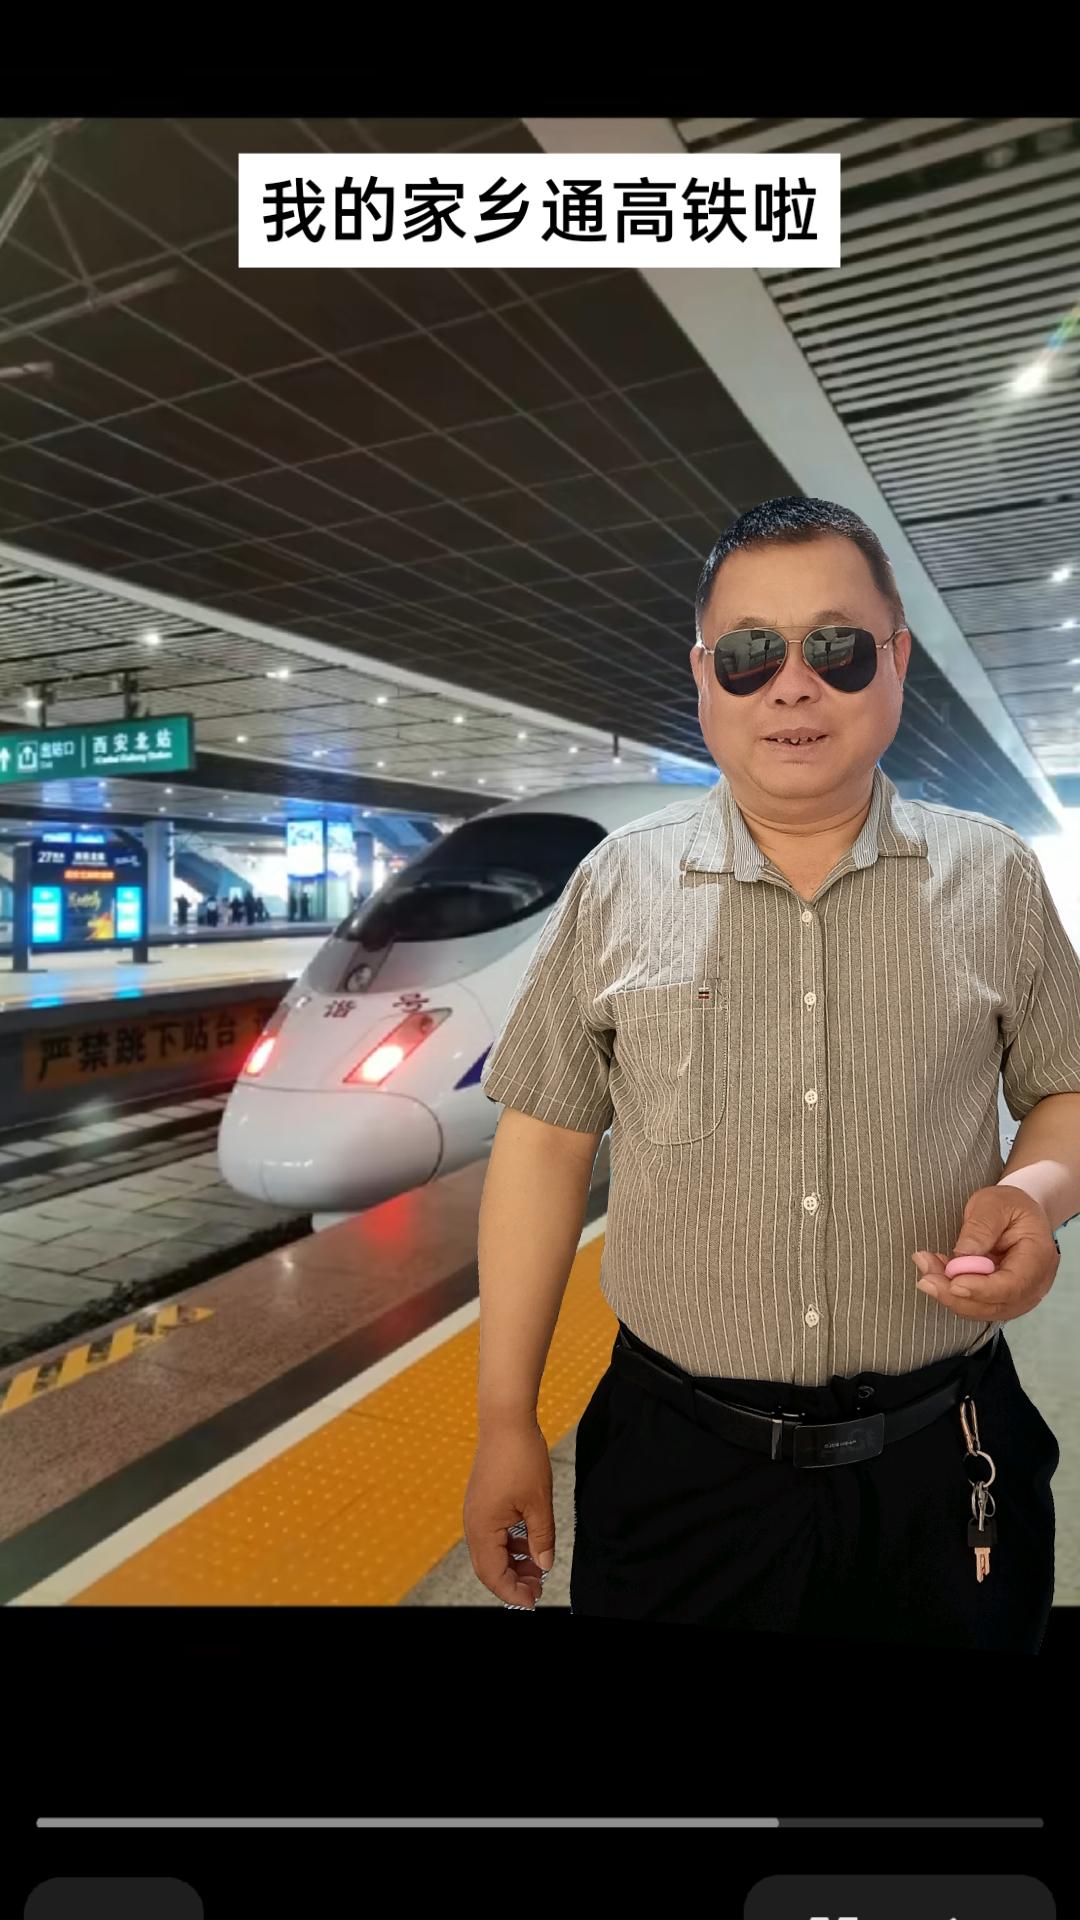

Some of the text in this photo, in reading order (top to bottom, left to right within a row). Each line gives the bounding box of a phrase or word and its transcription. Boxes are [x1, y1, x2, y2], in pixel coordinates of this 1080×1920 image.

[92, 729, 172, 755] 西安北站
[38, 1016, 237, 1082] 严禁跳下站台
